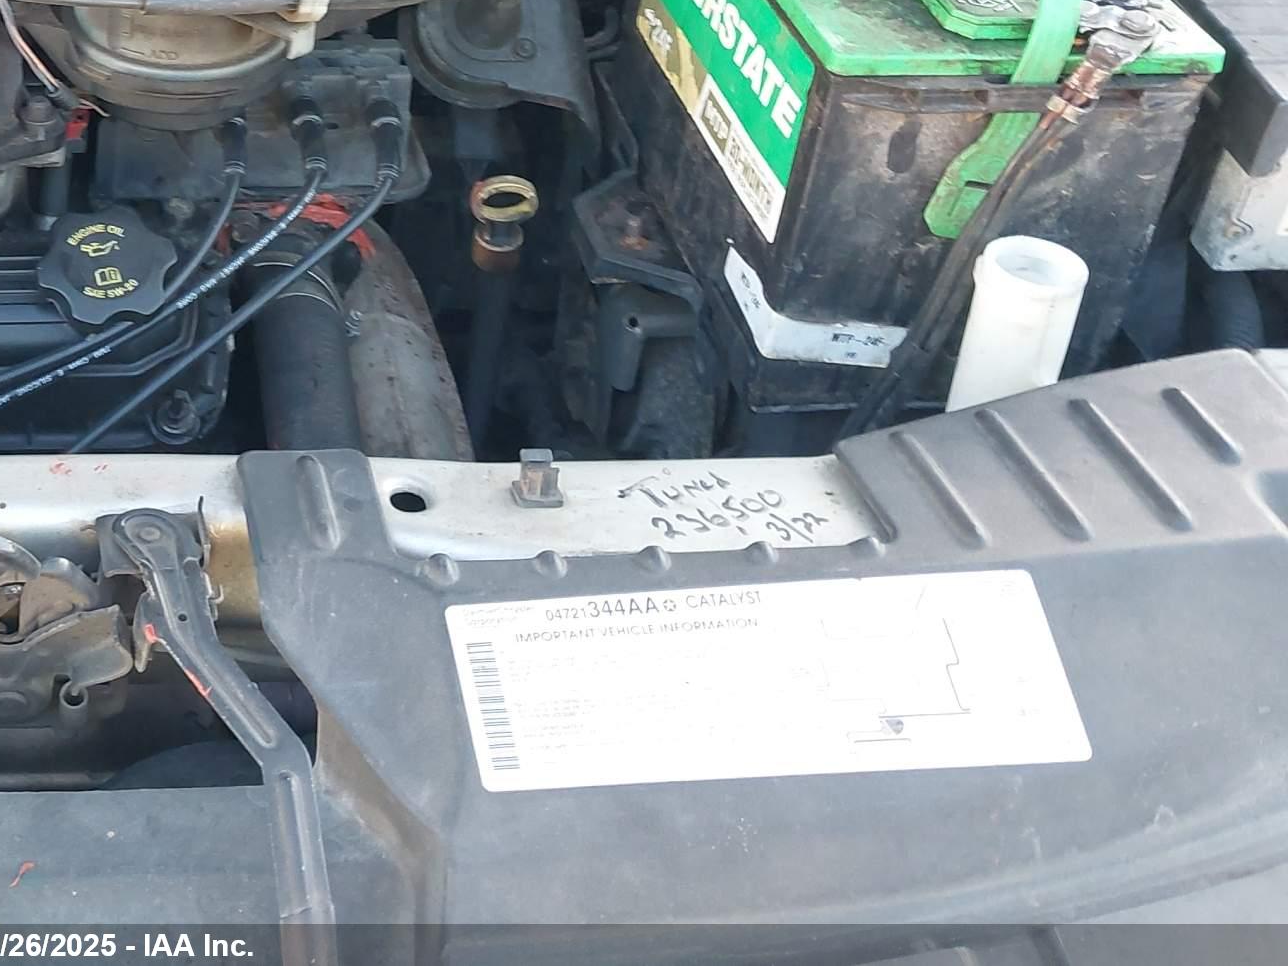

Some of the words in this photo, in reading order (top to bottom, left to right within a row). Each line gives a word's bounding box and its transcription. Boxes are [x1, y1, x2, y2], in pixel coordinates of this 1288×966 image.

[65, 222, 107, 247] ENGINE
[106, 223, 126, 238] OIL
[82, 285, 107, 300] SAE
[106, 278, 140, 299] 5W-20
[685, 590, 762, 609] CATALYST
[515, 627, 595, 643] IMPORTANT
[601, 623, 655, 638] VEHICLE
[660, 617, 759, 633] INFORMATION
